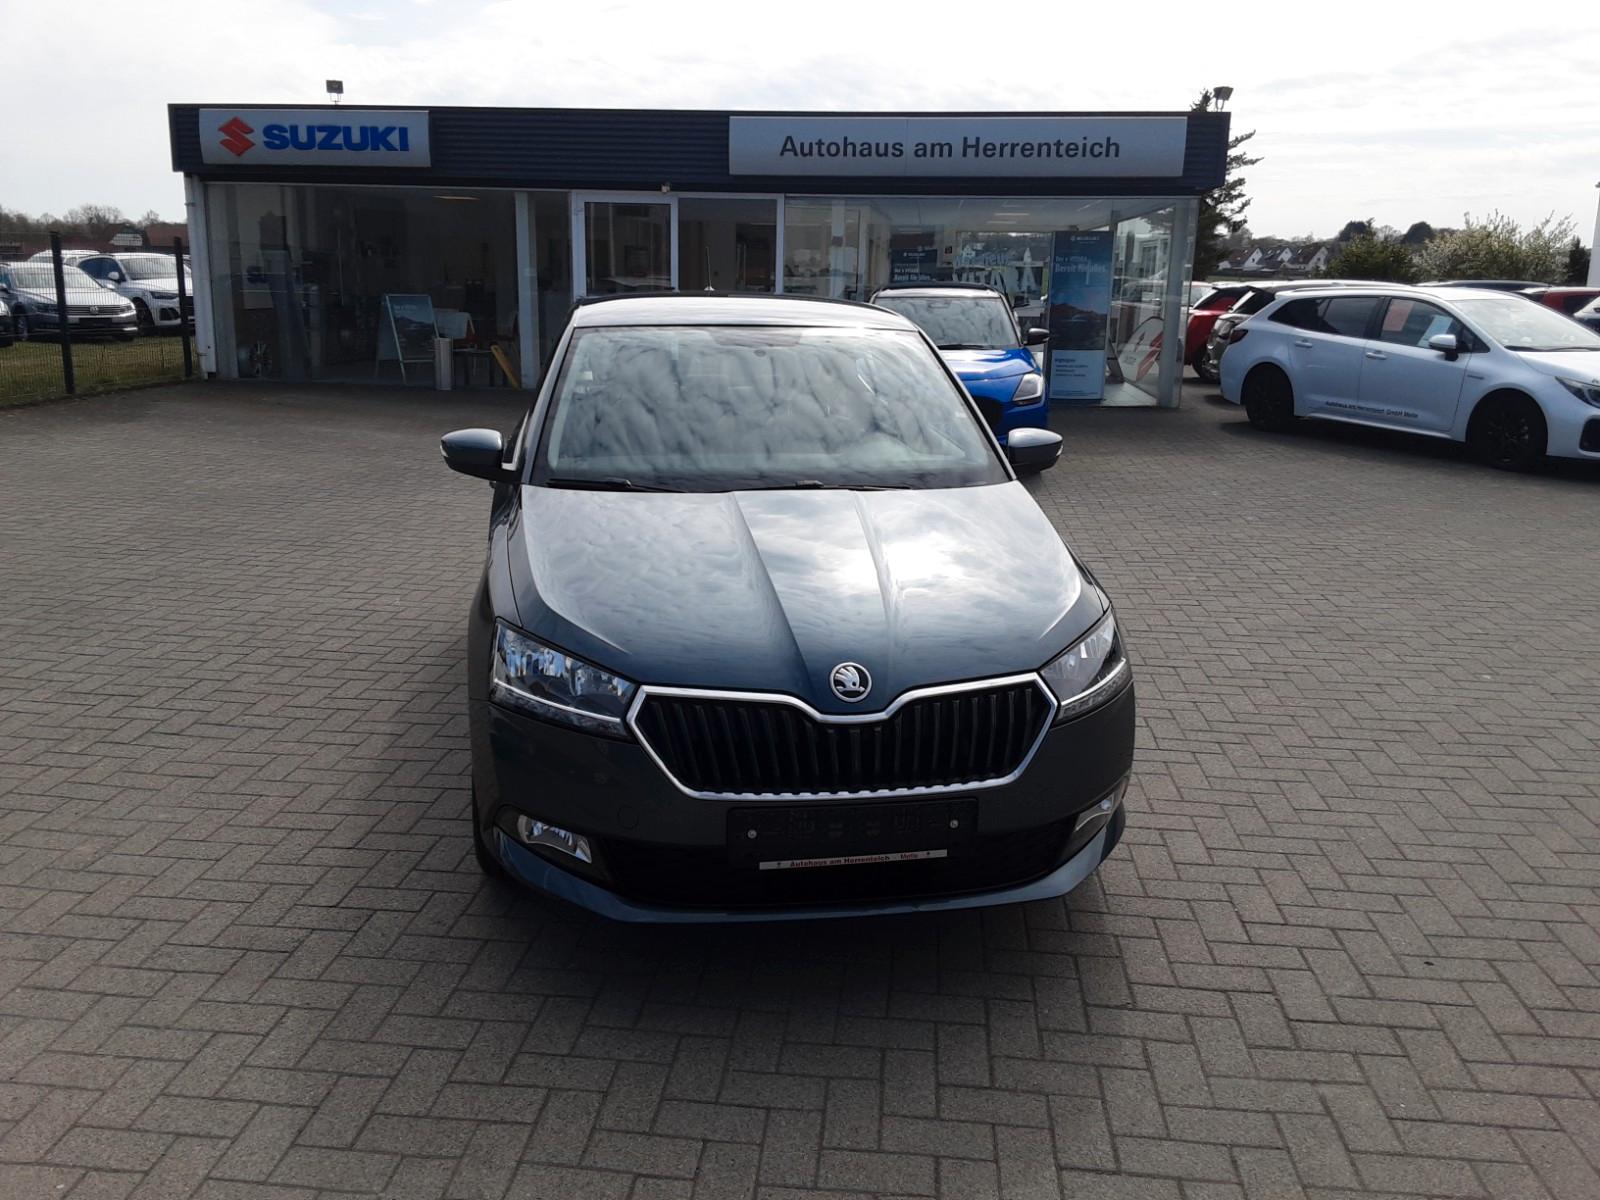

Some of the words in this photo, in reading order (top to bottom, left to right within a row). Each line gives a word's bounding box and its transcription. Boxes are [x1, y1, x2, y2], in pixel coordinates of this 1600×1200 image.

[262, 124, 409, 151] SUZUKI
[779, 135, 904, 158] Autohaus
[913, 140, 953, 158] am
[961, 135, 1120, 159] Herrenteich
[790, 859, 827, 868] Autohaus
[844, 855, 890, 865] Herrenteich
